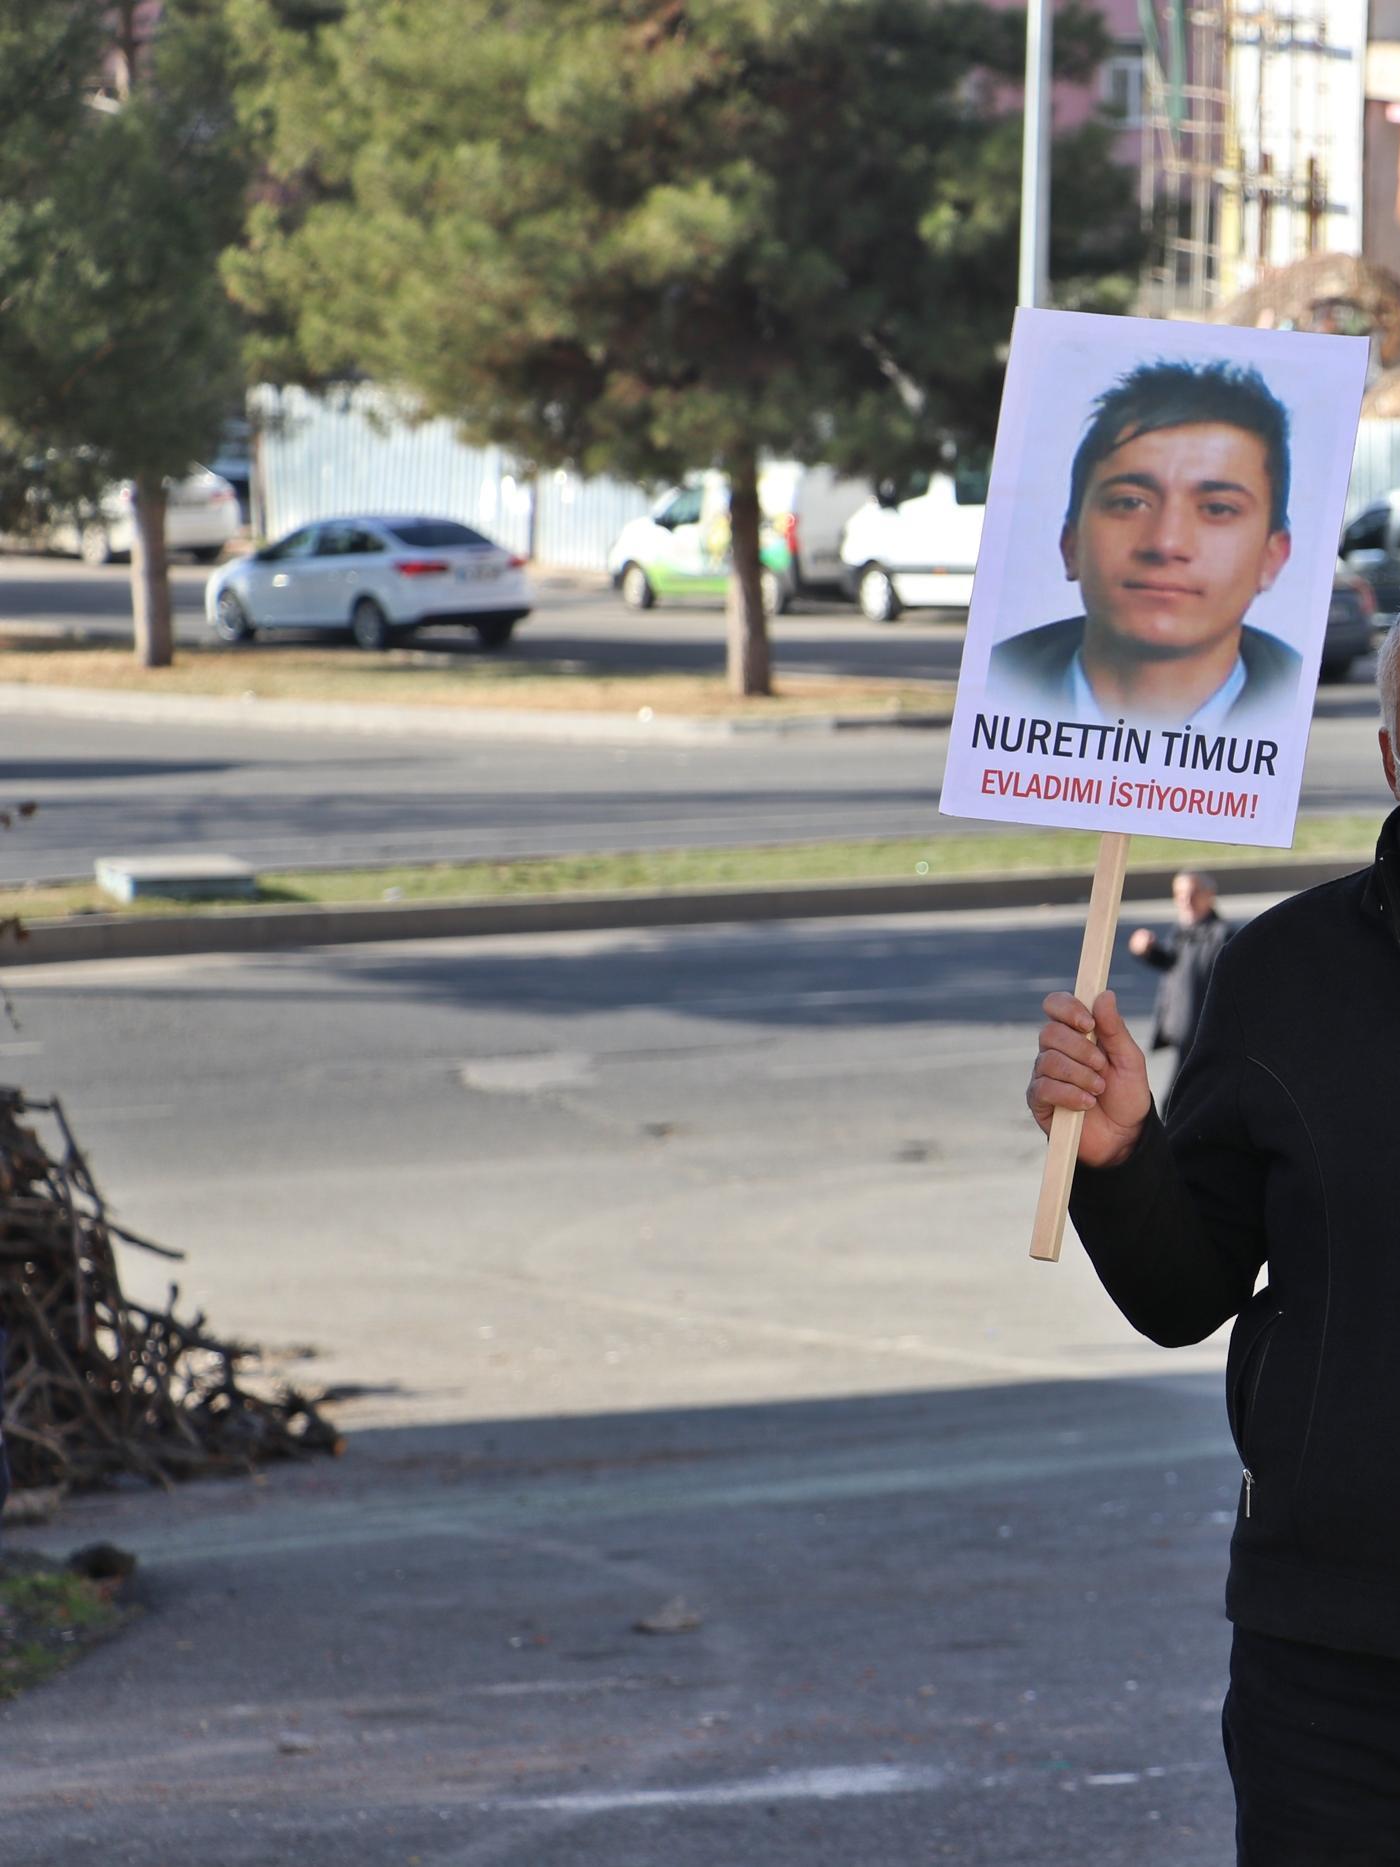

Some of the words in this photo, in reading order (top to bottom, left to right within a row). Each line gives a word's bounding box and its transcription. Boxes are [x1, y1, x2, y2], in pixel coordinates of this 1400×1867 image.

[971, 713, 1151, 765] NURETTİN
[1161, 724, 1279, 776] TİMUR
[980, 769, 1102, 804] EVLADIMI
[1108, 775, 1259, 819] İSTİYORUM!
